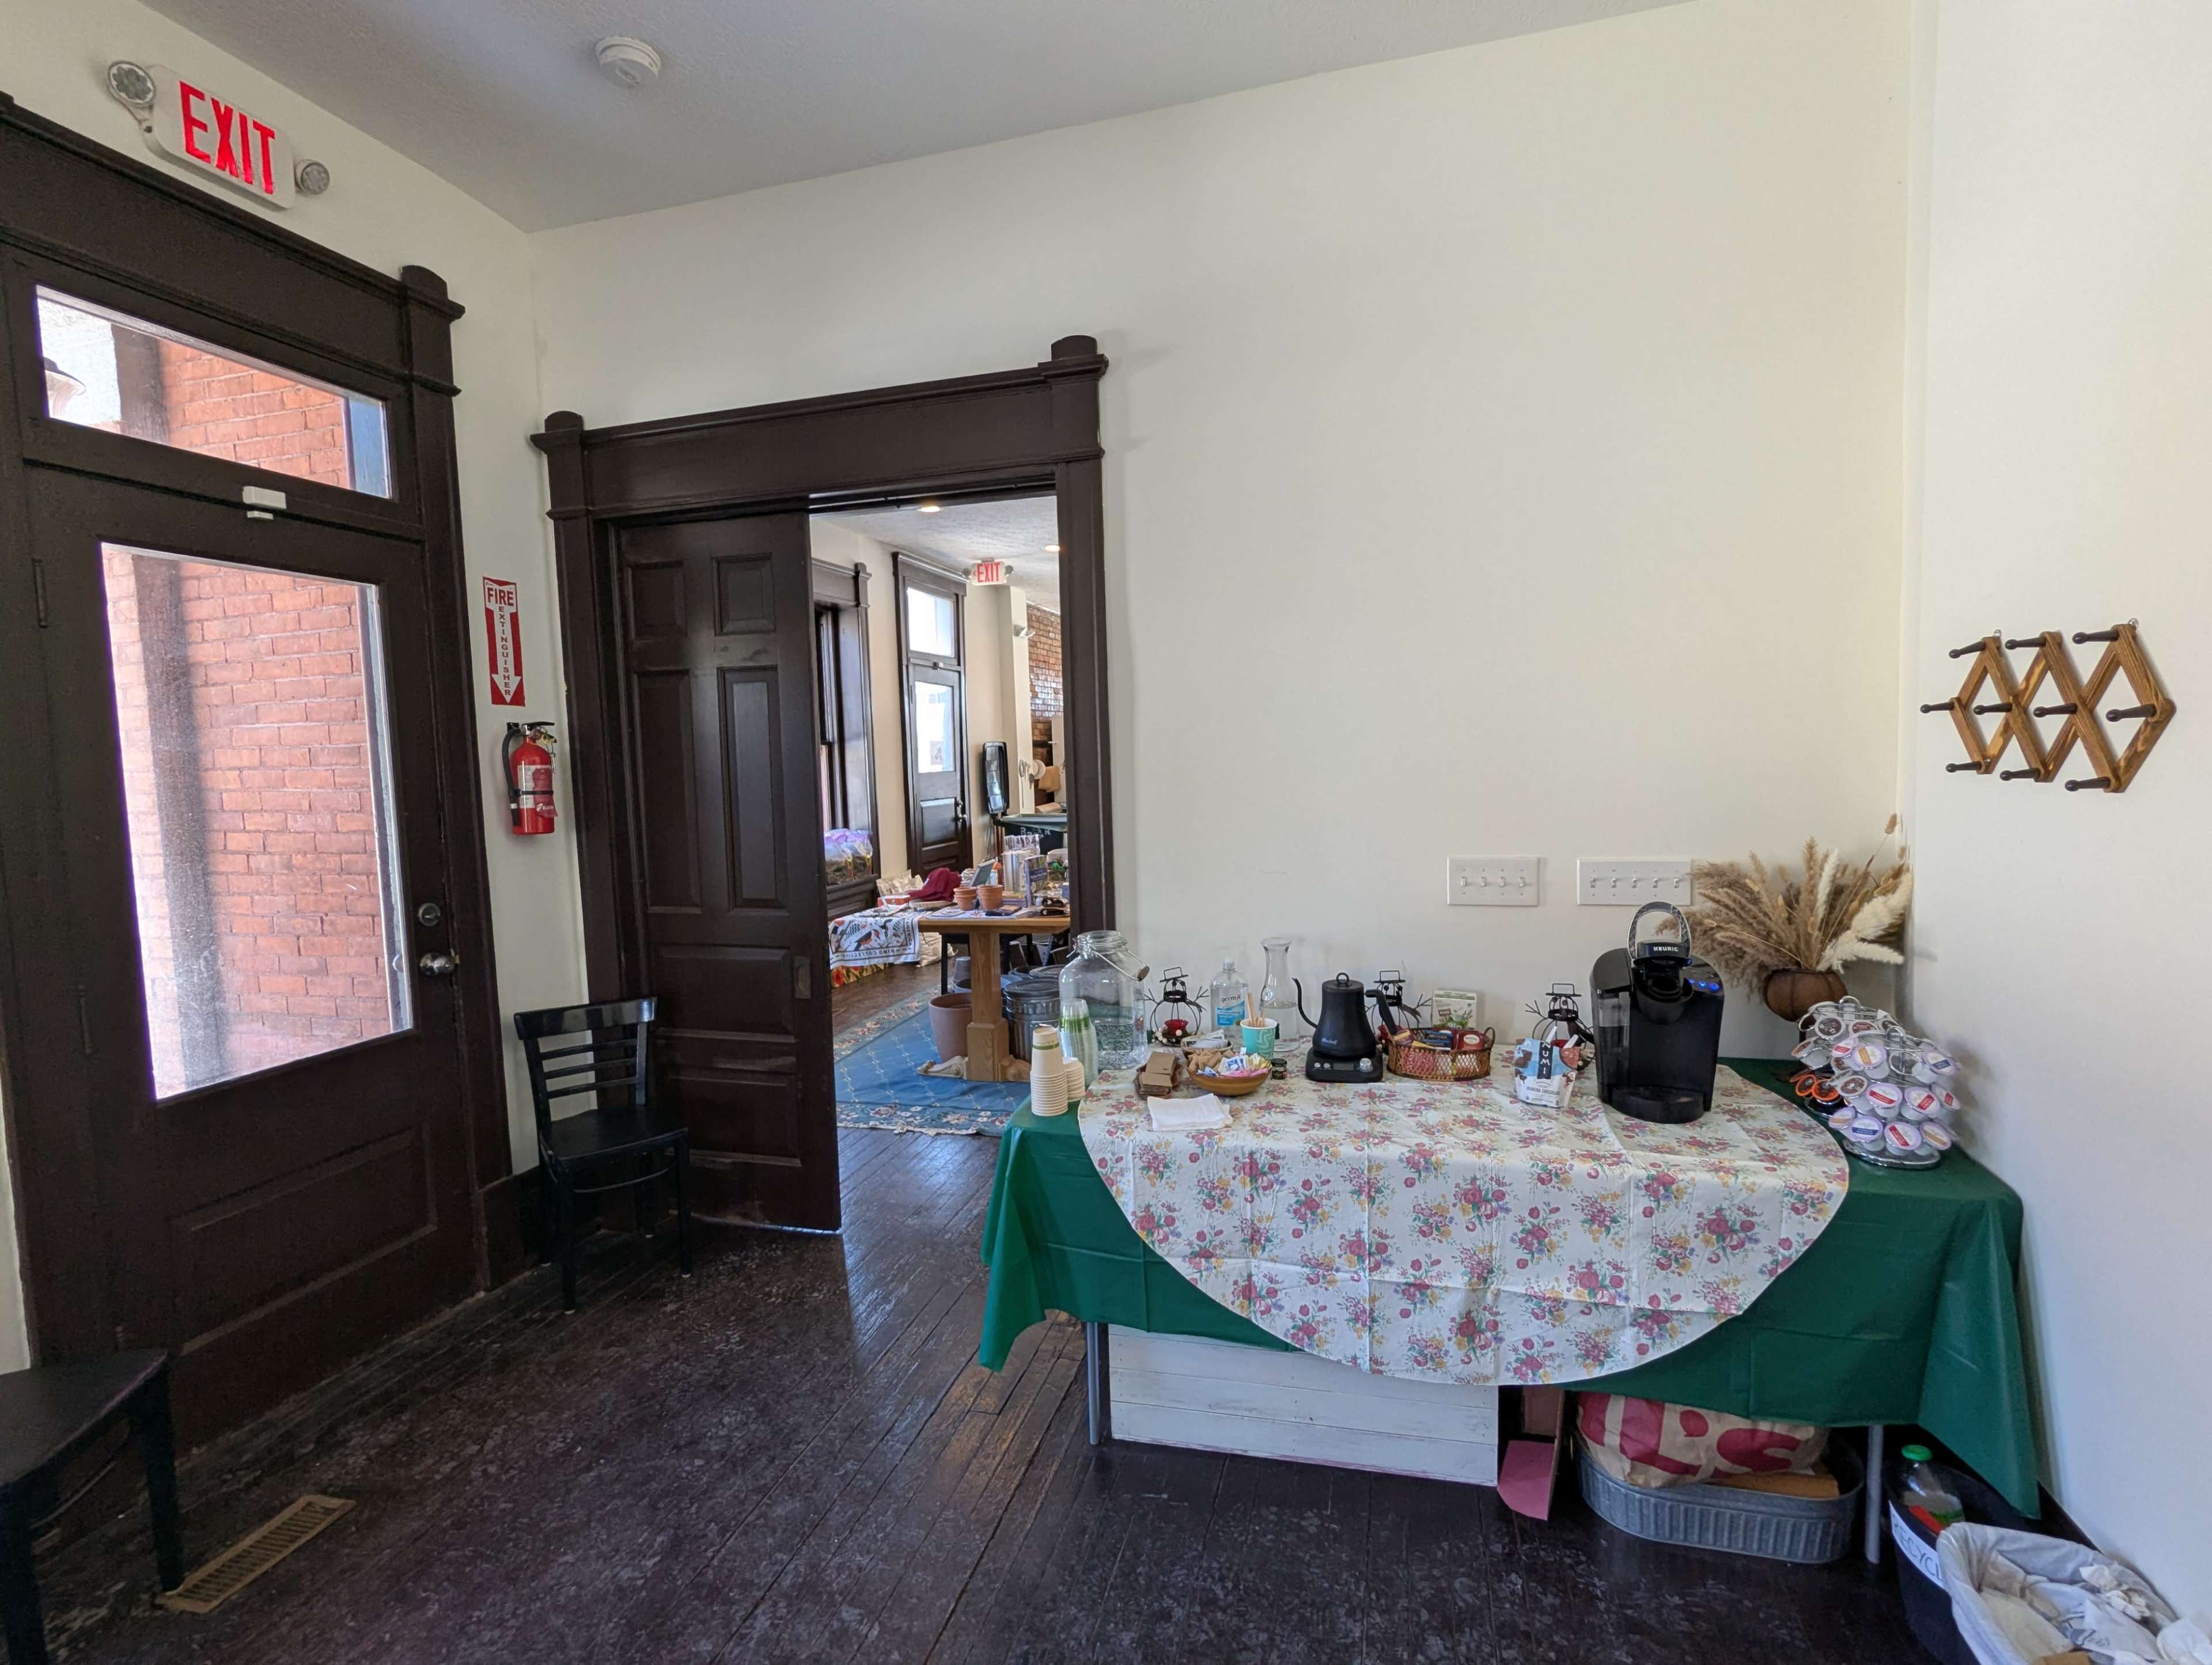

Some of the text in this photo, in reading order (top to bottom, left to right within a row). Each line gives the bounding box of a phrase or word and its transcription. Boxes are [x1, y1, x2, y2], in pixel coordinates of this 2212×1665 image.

[179, 81, 276, 195] EXIT
[977, 563, 1001, 583] EXIT
[487, 587, 514, 606] FIRE
[498, 606, 512, 696] EXTINGUISHER
[1540, 1042, 1551, 1074] NUMI
